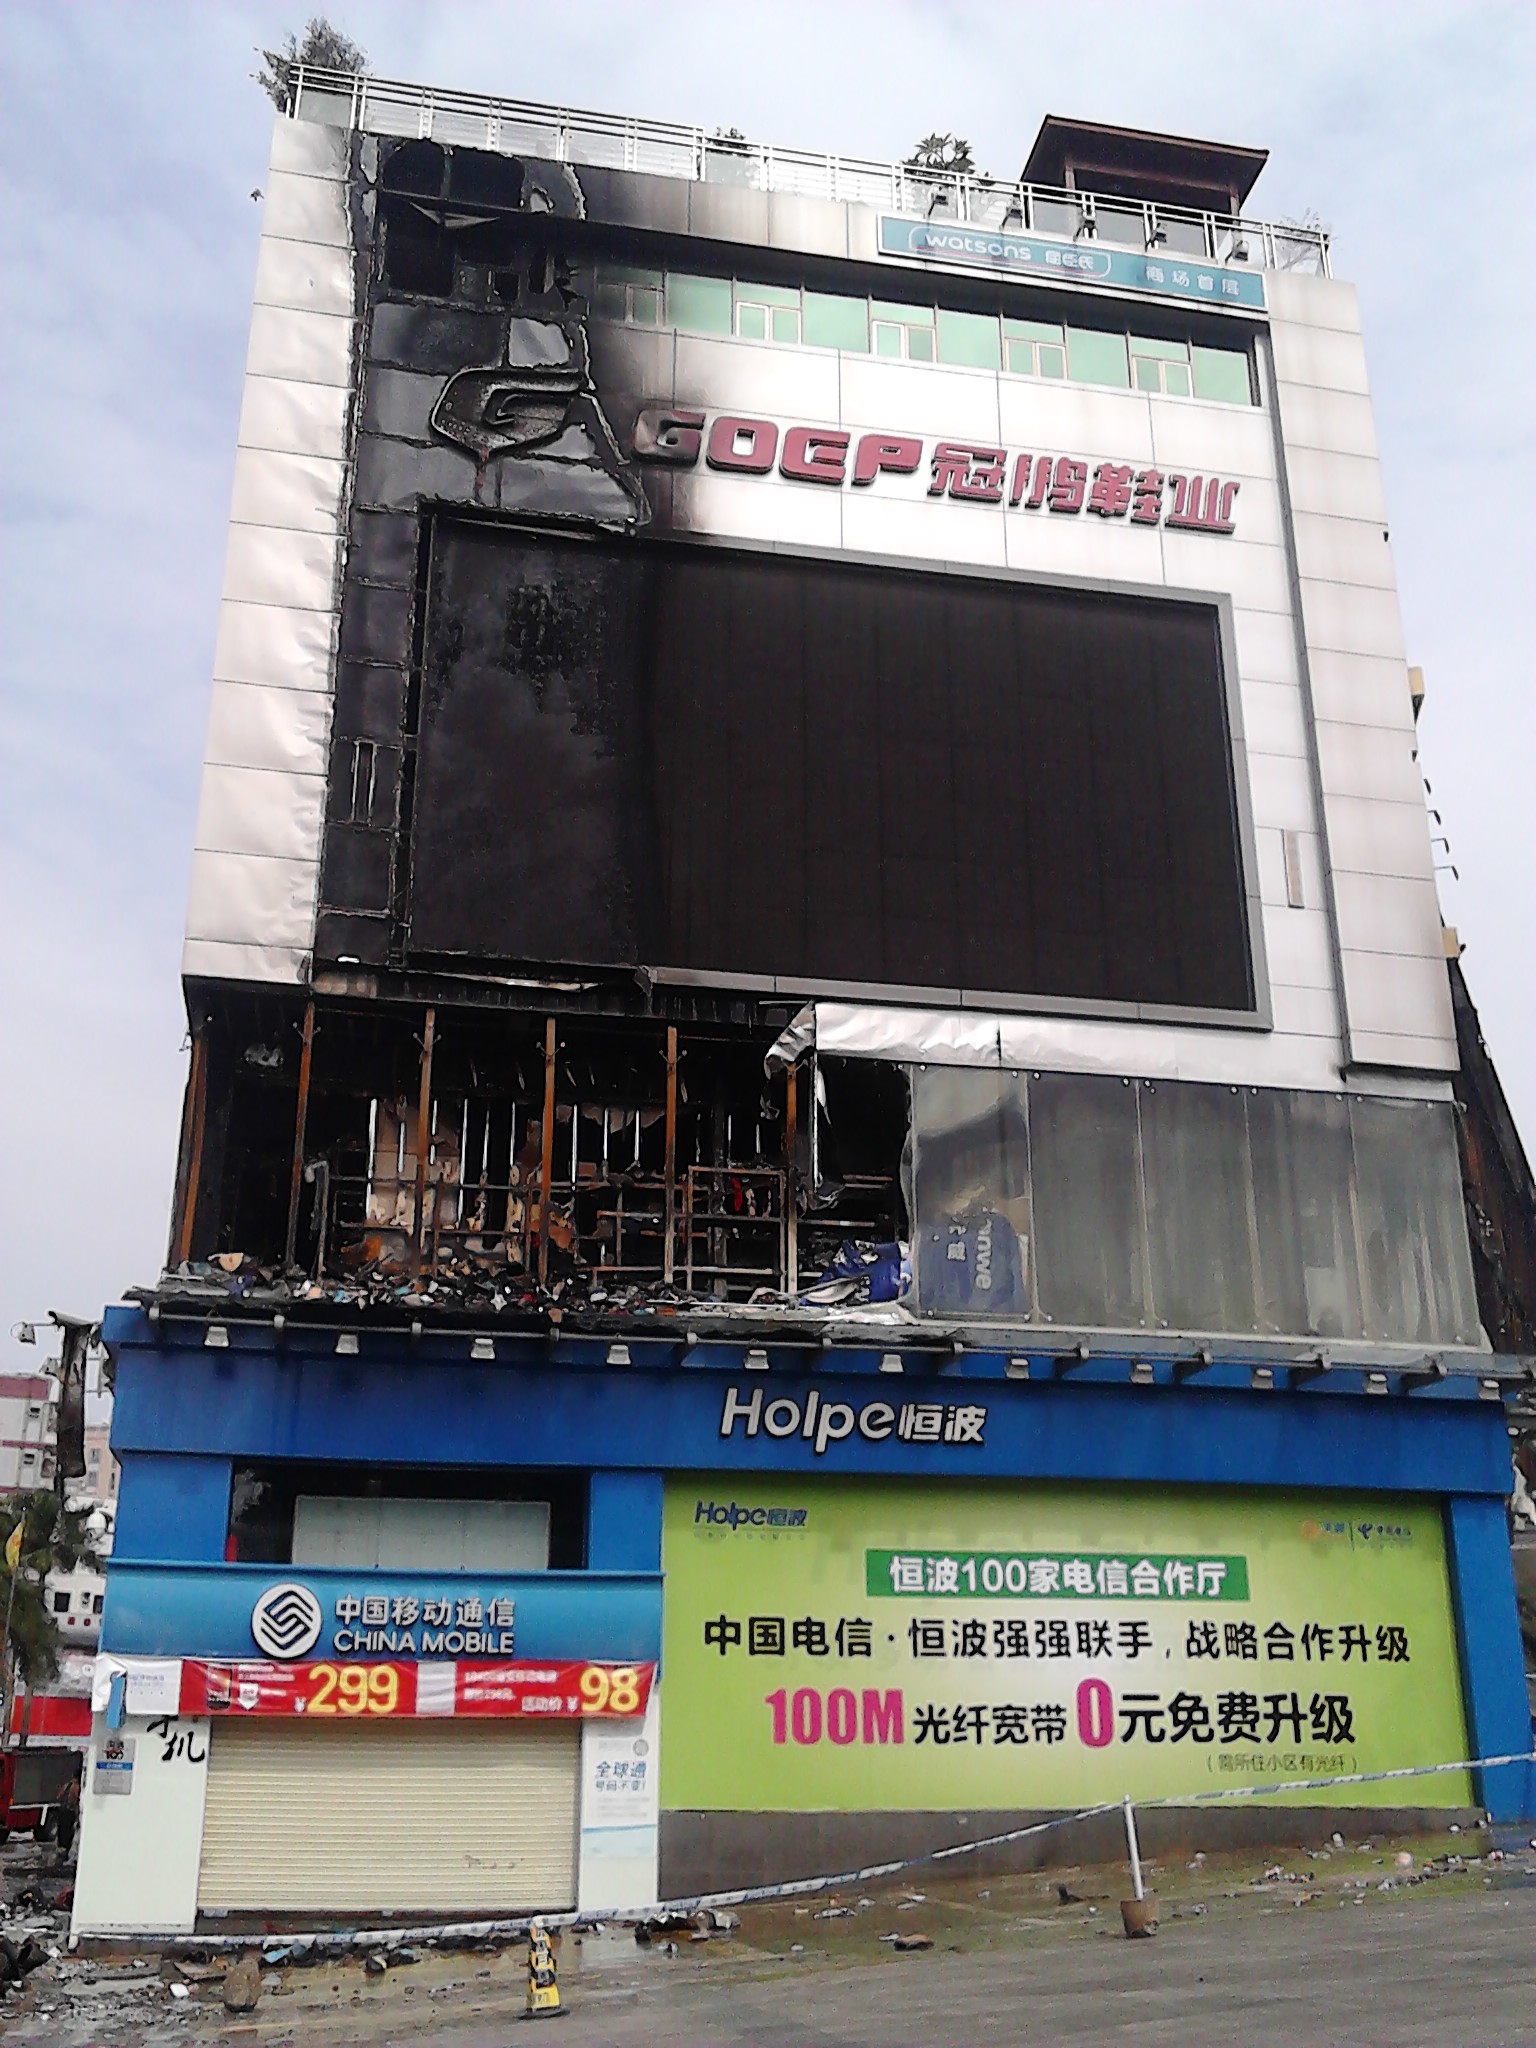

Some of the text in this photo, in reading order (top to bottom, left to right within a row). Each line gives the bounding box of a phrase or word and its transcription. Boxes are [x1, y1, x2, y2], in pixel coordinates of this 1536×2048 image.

[925, 231, 1031, 262] watsons
[631, 409, 1241, 535] GOEP 冠鹏鞋业
[719, 1387, 987, 1454] Holpe 恒波
[694, 1501, 767, 1530] Holpe
[889, 1554, 1228, 1598] 恒波100家电信合作厅
[334, 1595, 516, 1627] 中国移动通信
[334, 1630, 515, 1655] CHINA MOBILE
[764, 1687, 905, 1746] 100M
